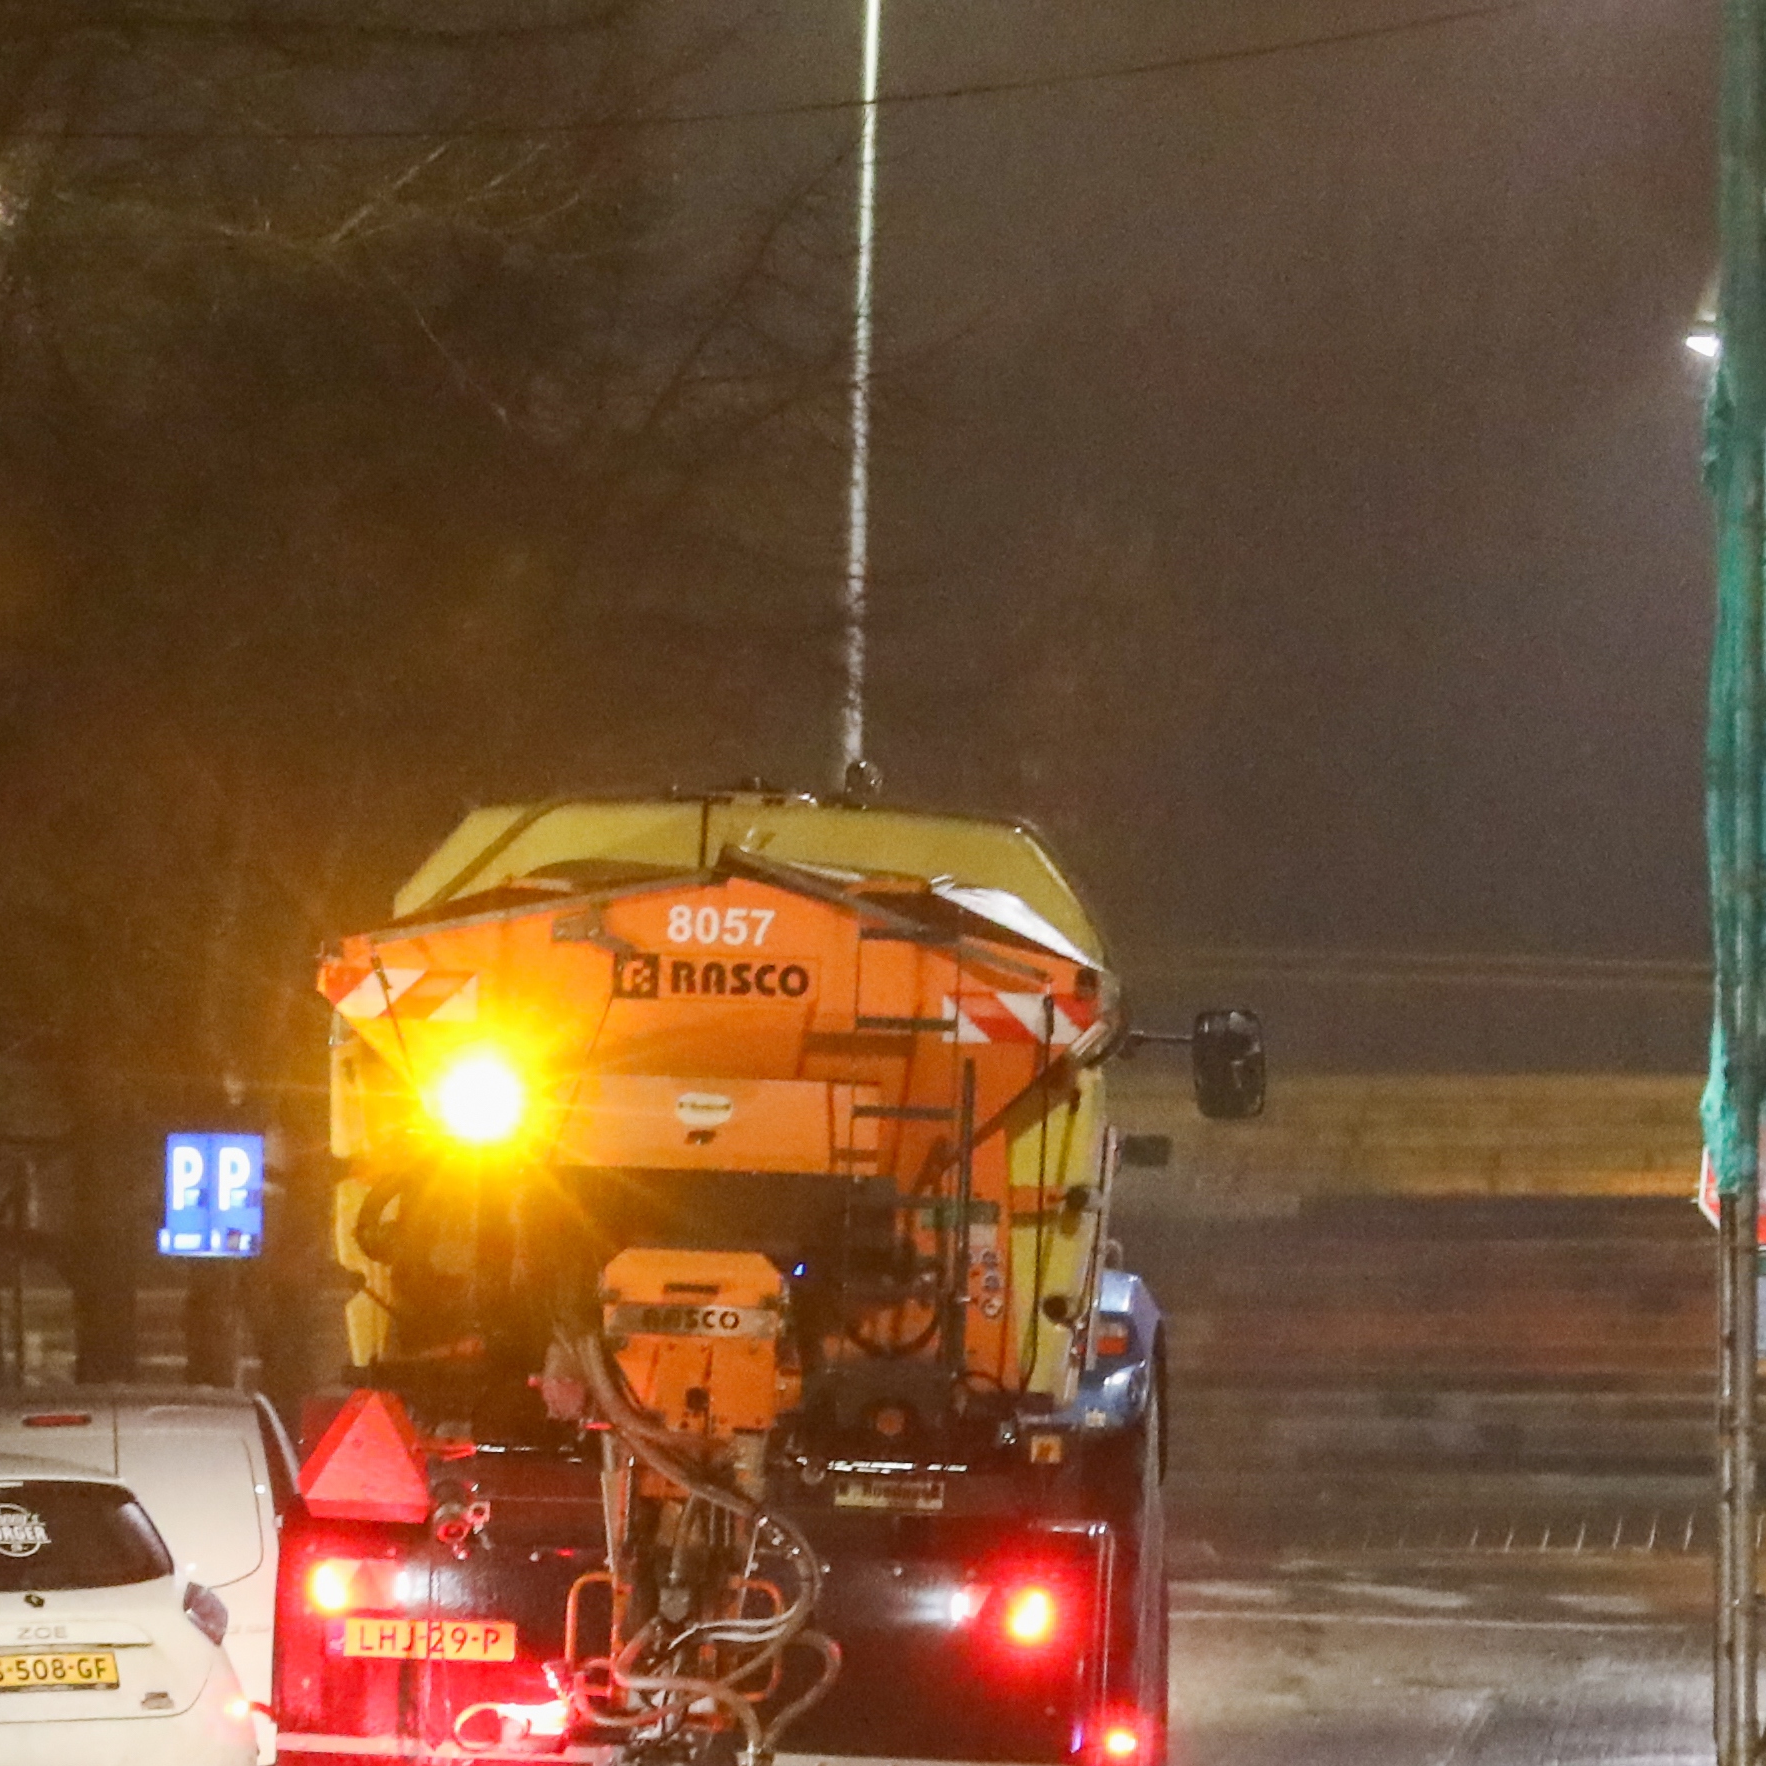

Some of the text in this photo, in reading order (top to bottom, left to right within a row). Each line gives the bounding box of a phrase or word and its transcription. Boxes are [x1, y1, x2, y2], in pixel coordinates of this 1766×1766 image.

[667, 904, 775, 946] 8057
[670, 960, 810, 997] RASCO
[173, 1146, 203, 1211] P
[219, 1147, 250, 1211] P
[17, 1626, 68, 1640] ZOE
[359, 1624, 501, 1655] LHJ-29-P
